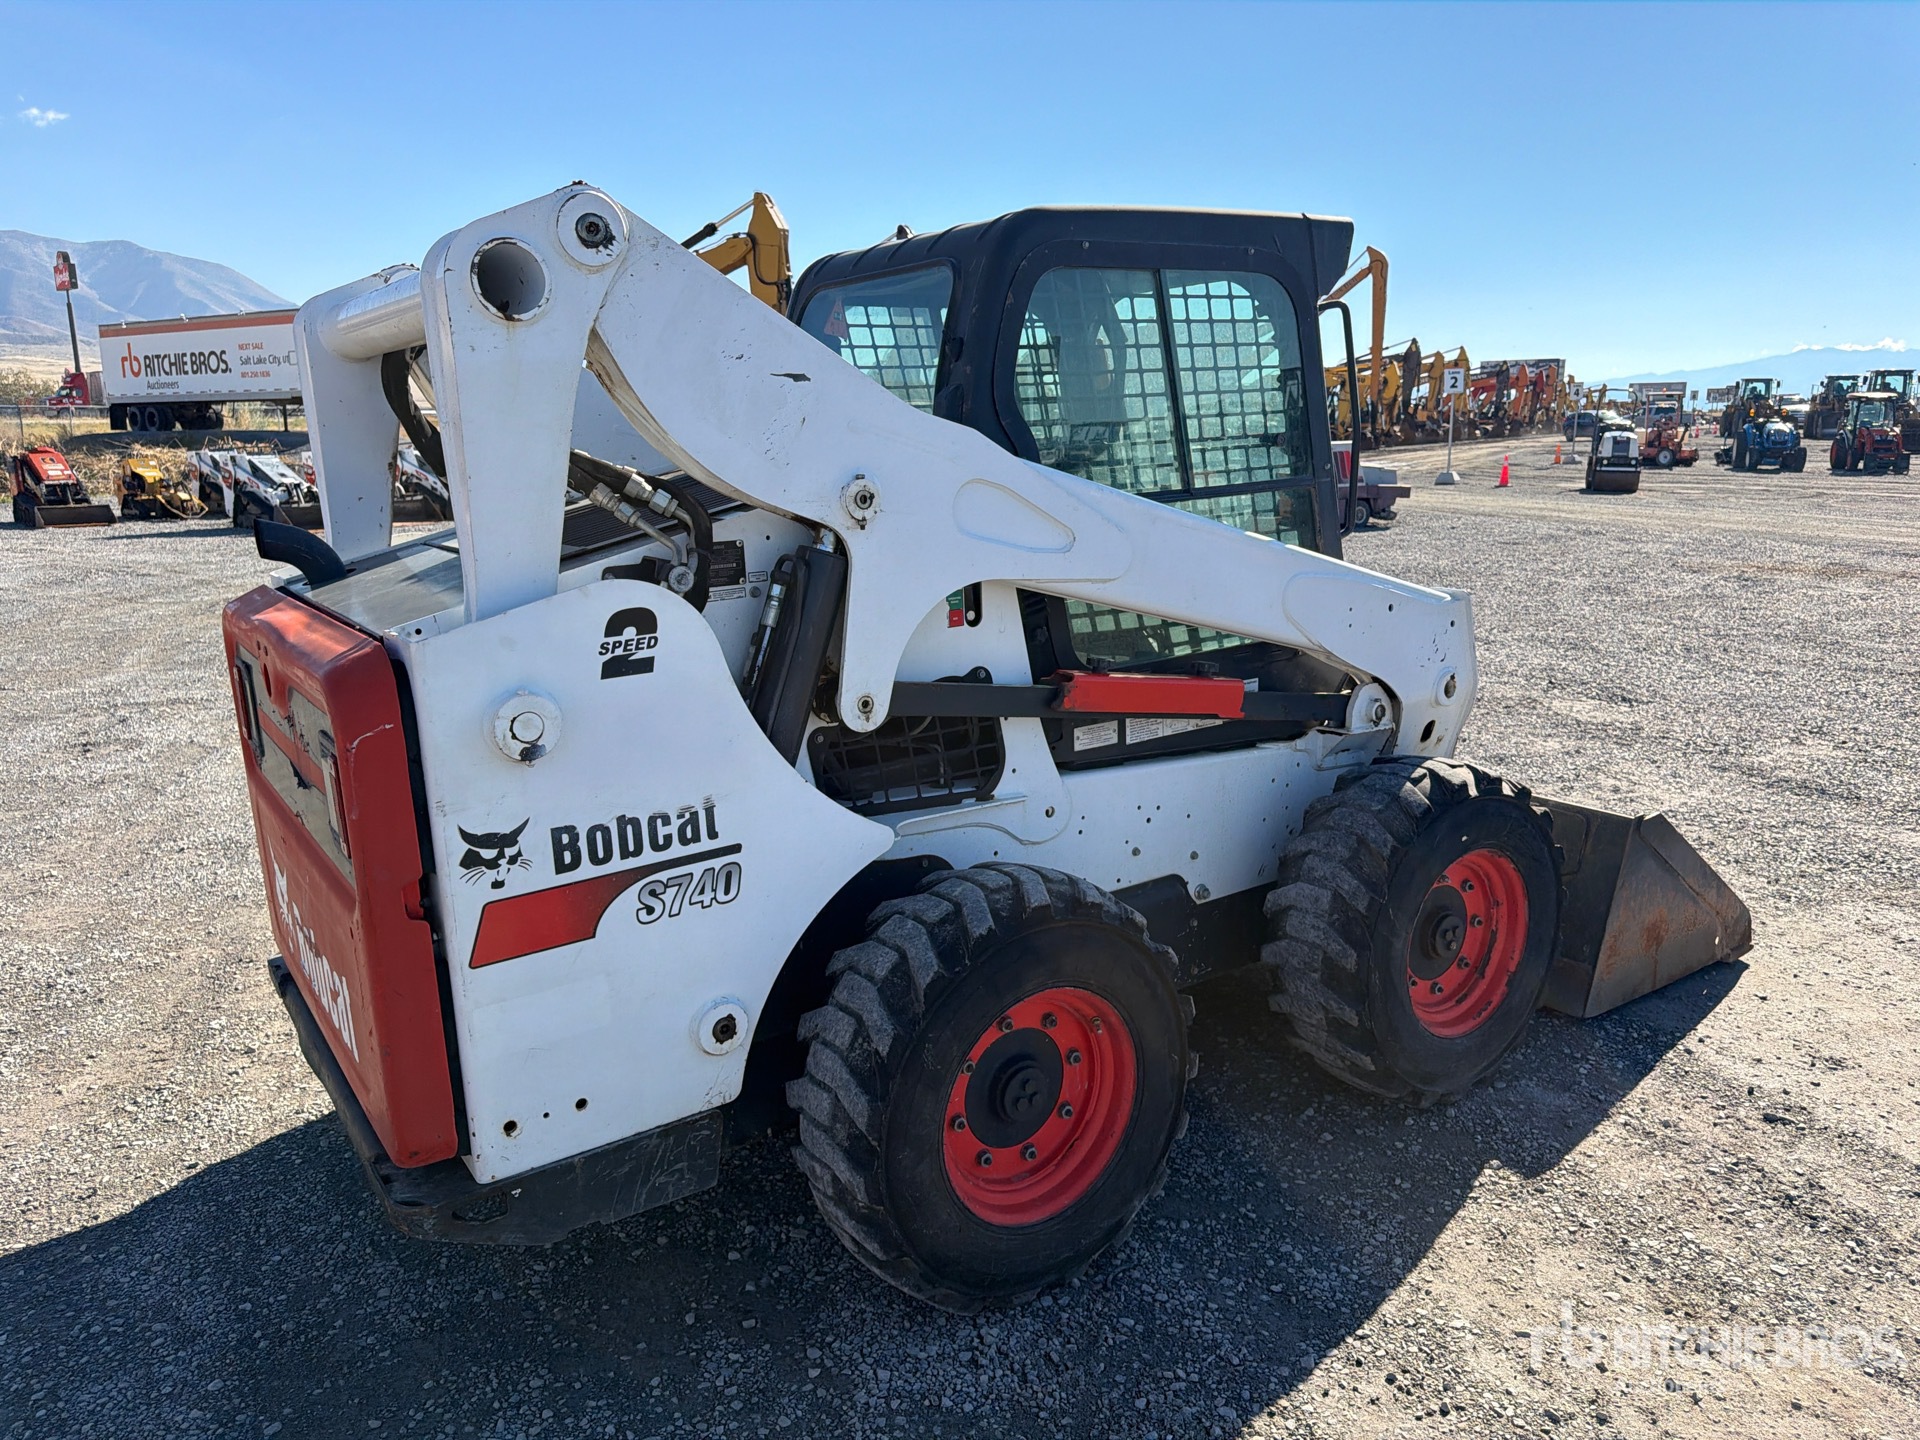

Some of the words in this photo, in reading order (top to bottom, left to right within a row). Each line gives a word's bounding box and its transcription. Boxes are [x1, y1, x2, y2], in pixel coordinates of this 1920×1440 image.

[238, 343, 251, 351] NEXT
[251, 342, 264, 350] SALE
[144, 353, 189, 377] RITCHIE
[190, 350, 232, 374] BROS.
[240, 355, 252, 366] Salt
[252, 354, 267, 365] Lake
[146, 380, 179, 390] Auctioneers
[1449, 376, 1459, 389] 2
[1573, 388, 1580, 398] 4
[598, 635, 659, 656] SPEED
[550, 795, 719, 875] Bobcat
[636, 862, 742, 925] S740
